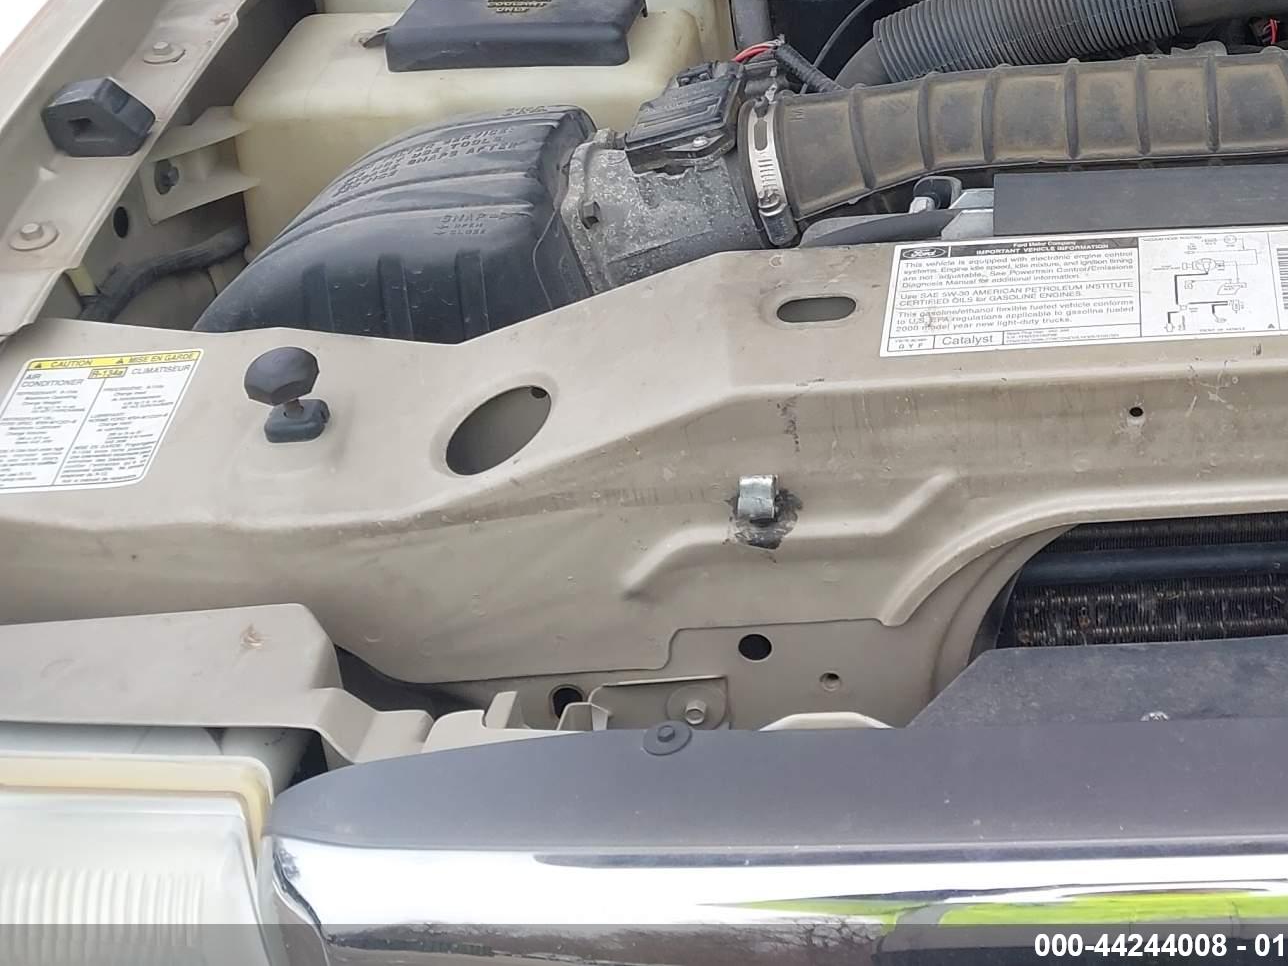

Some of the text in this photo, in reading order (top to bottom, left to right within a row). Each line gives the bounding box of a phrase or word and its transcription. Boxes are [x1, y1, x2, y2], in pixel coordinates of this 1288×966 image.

[1047, 239, 1076, 247] Company
[1057, 243, 1109, 251] INFORMATION
[940, 266, 968, 274] Engine
[1080, 258, 1108, 266] ignition
[1109, 257, 1133, 265] timing
[969, 257, 1008, 266] equipped
[1056, 263, 1134, 273] Control/Emissions
[902, 280, 942, 289] Diagnosis
[941, 290, 970, 298] 5W-30
[973, 288, 1022, 296] AMERICAN
[1024, 284, 1082, 293] PETROLEUM
[1086, 282, 1133, 290] INSTITUTE
[899, 298, 950, 306] CERTIFIED
[988, 293, 1036, 301] GASOLINE
[920, 307, 994, 318] gasoline/ethanol
[996, 305, 1028, 313] flexible
[1093, 300, 1134, 308] conforms
[952, 313, 1002, 323] regulations
[1006, 311, 1052, 320] applicable
[1066, 308, 1103, 317] gasoline
[997, 319, 1039, 328] light-duty
[942, 334, 993, 346] Catalyst
[51, 360, 93, 368] CAUTION
[93, 369, 124, 378] R-134a
[131, 364, 191, 374] CLIMATISEUR
[21, 379, 85, 388] CONDITIONER
